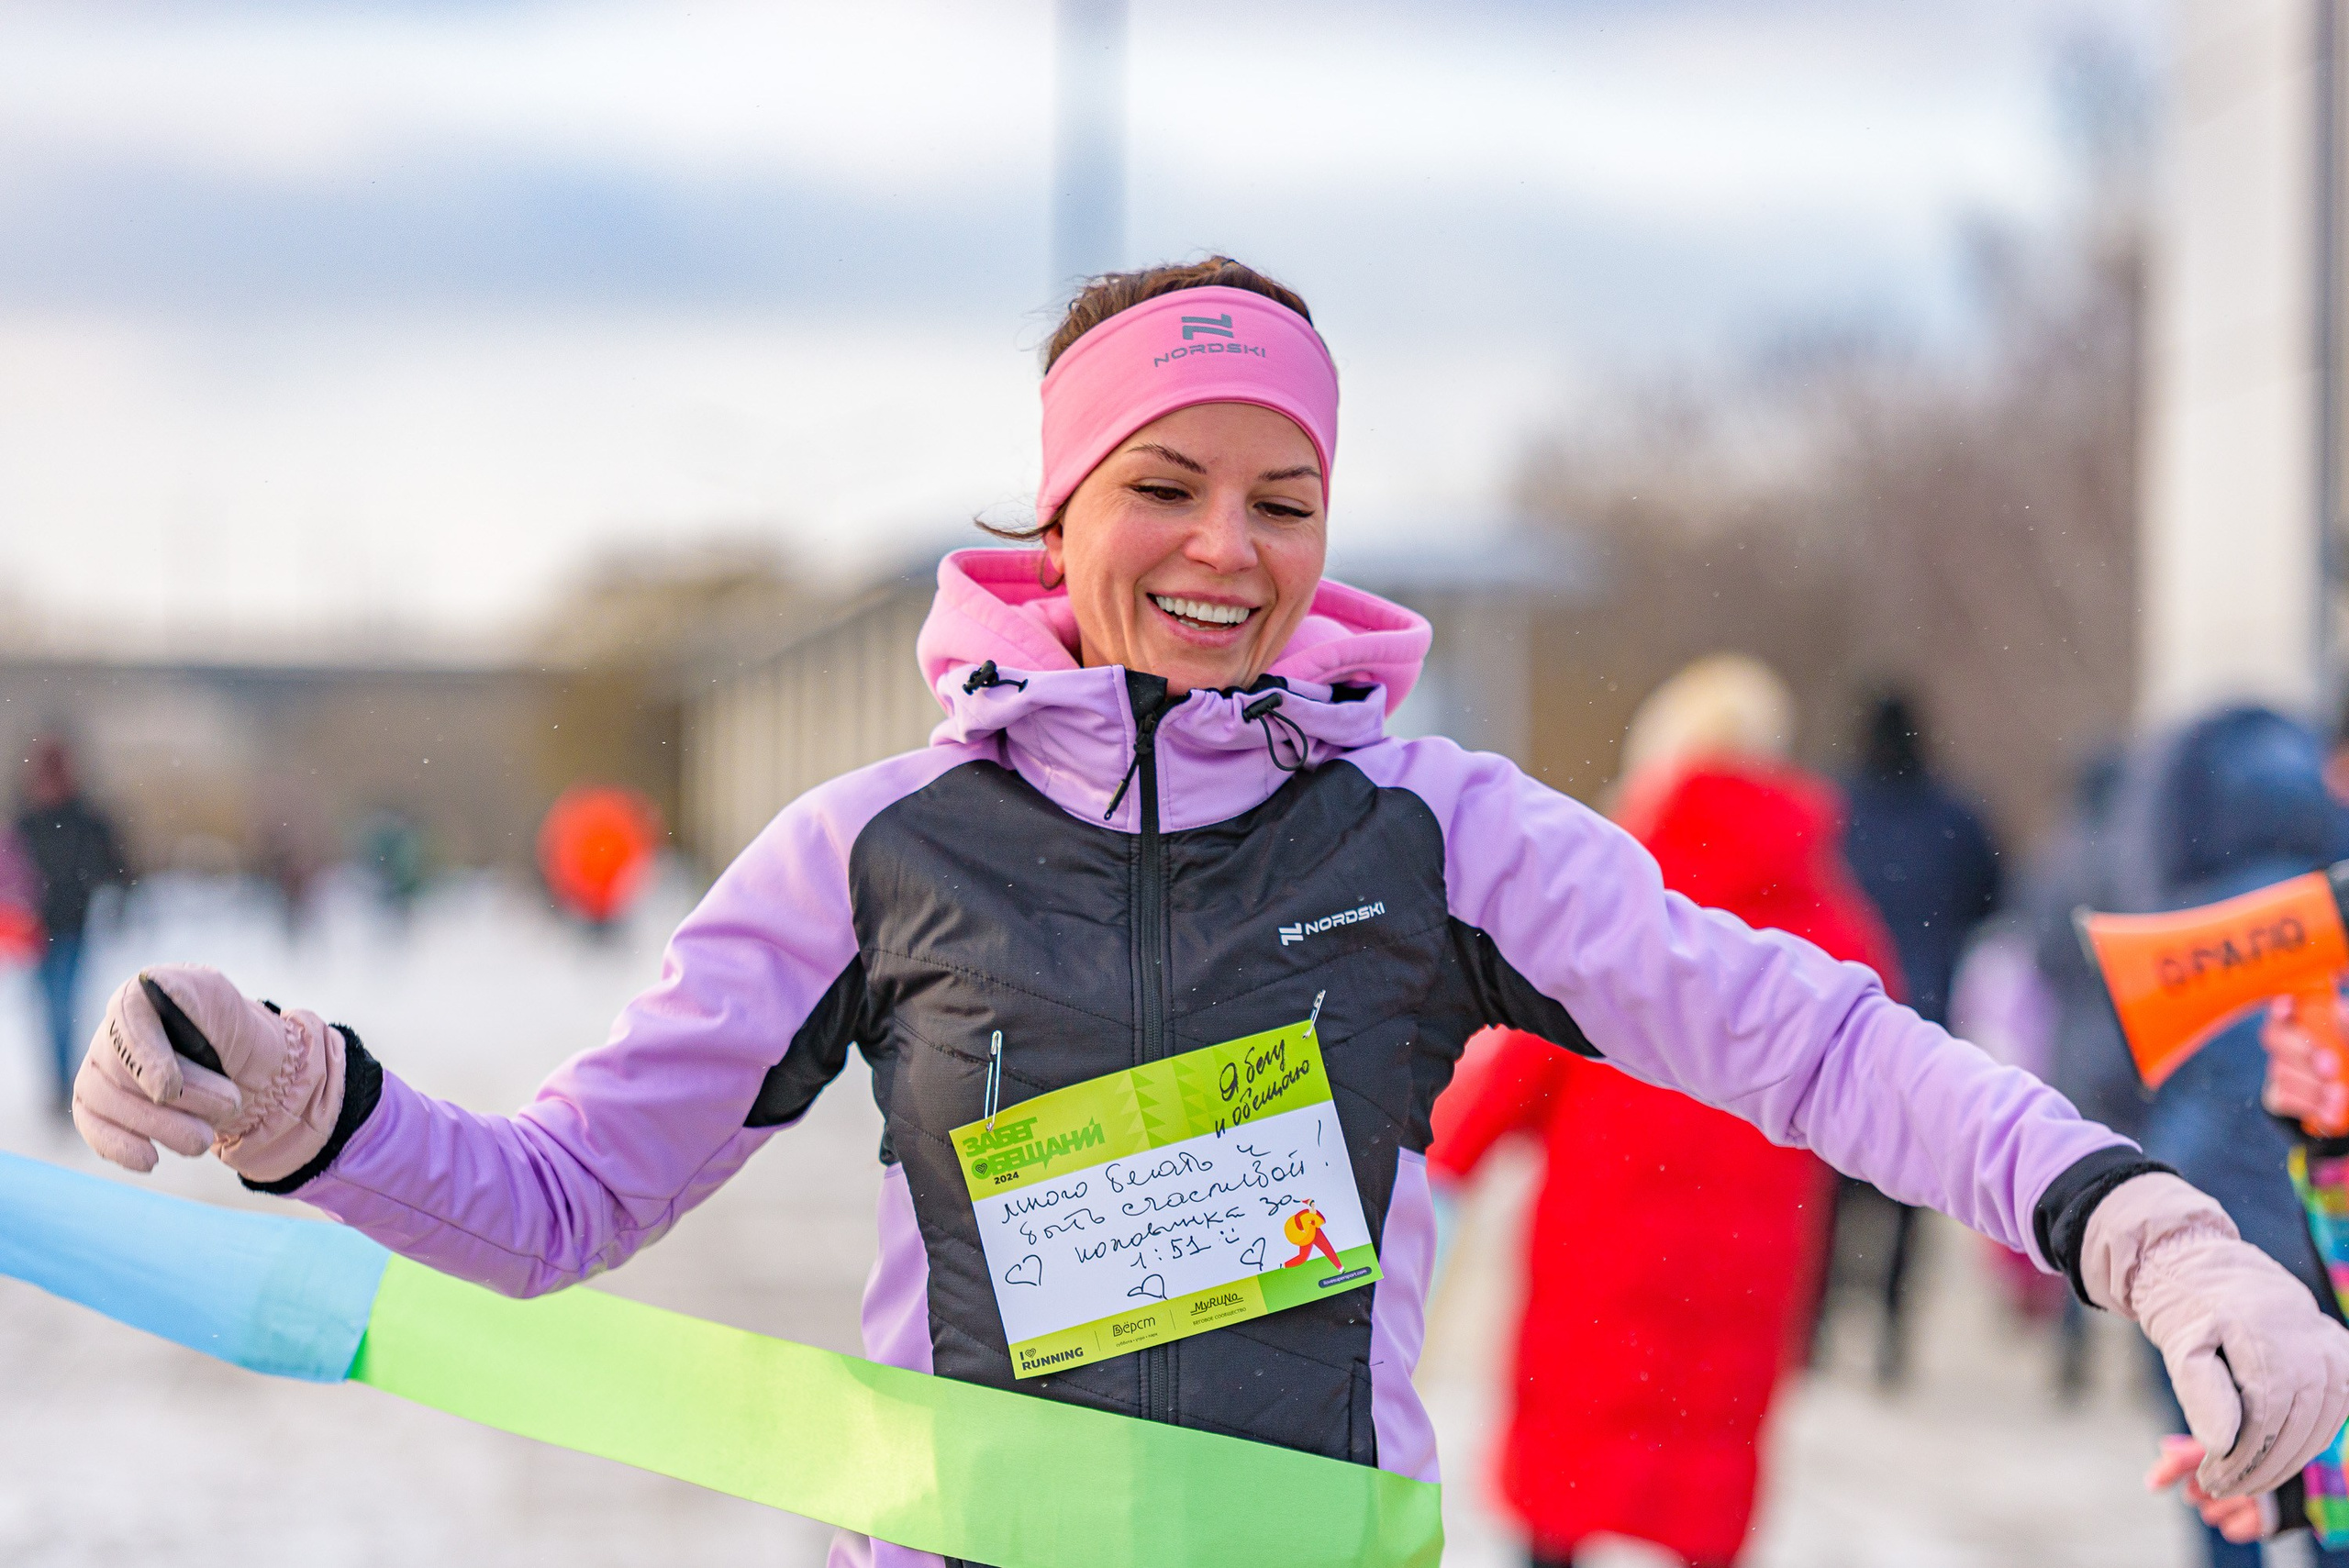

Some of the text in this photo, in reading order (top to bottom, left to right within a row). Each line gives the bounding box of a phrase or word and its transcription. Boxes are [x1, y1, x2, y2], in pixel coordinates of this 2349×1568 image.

[1154, 343, 1266, 367] NORDSKI
[1305, 901, 1386, 935] NORDSKI
[962, 1117, 1038, 1158] ЗАБЕГ
[994, 1172, 1019, 1185] 2024
[1130, 1235, 1213, 1270] 1:51
[1022, 1347, 1085, 1372] RUNNING
